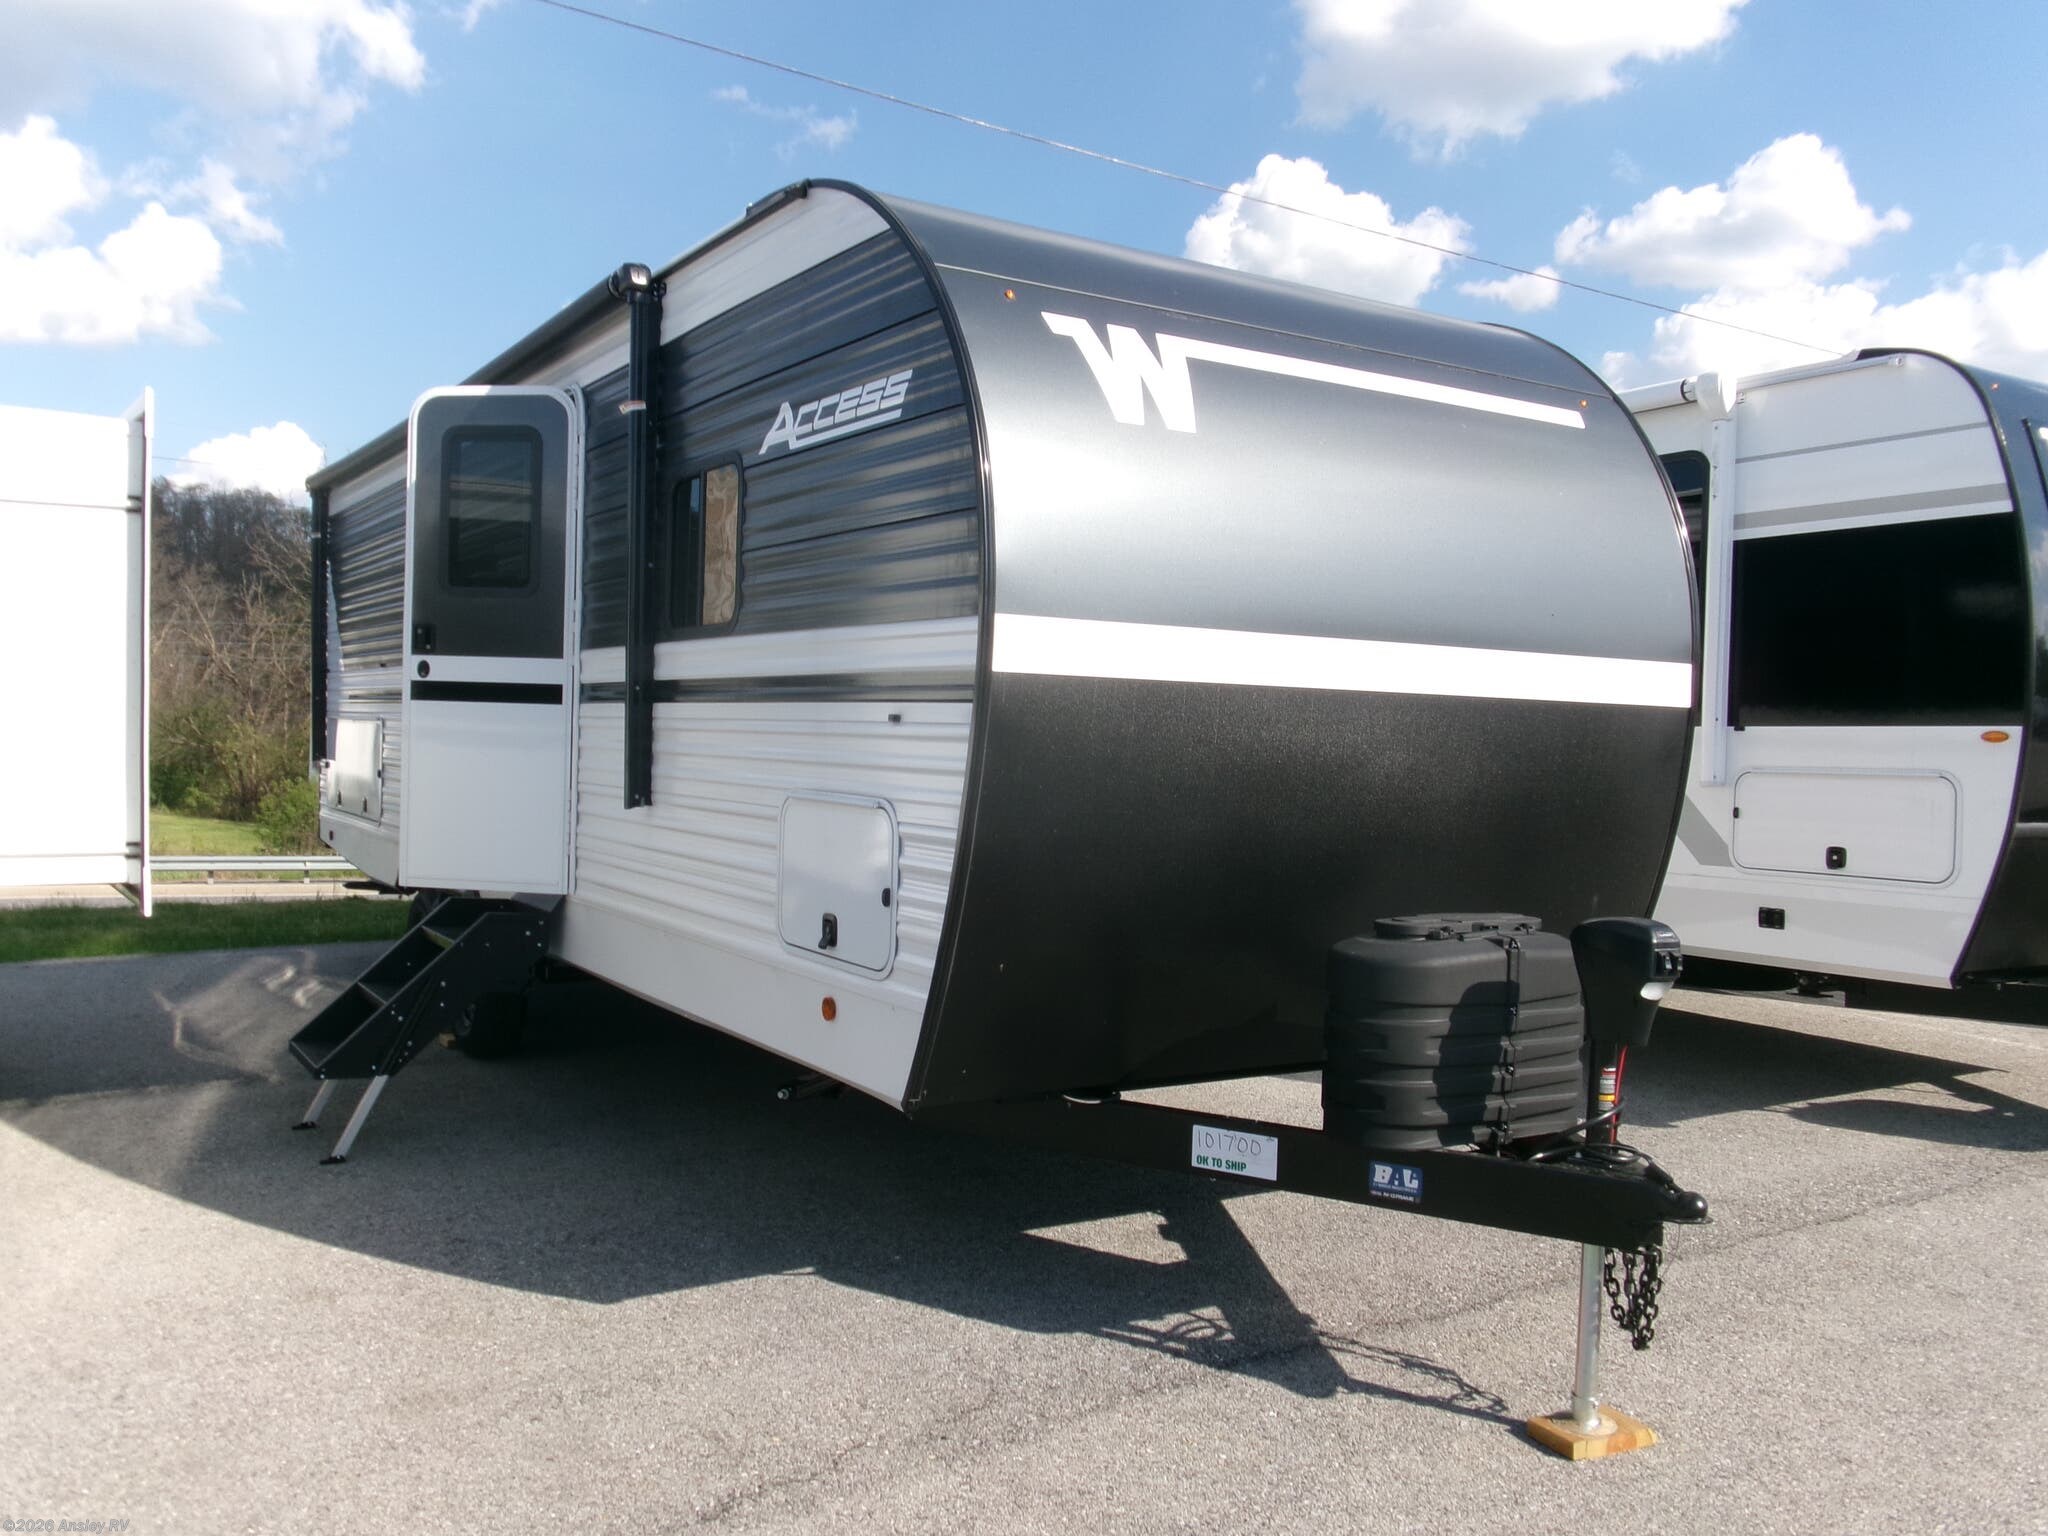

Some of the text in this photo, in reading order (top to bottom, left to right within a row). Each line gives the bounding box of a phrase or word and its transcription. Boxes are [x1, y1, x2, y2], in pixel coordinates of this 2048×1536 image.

[758, 369, 913, 455] ACCESS
[1197, 1129, 1262, 1156] 101700
[1196, 1154, 1247, 1172] OK TO SHIP
